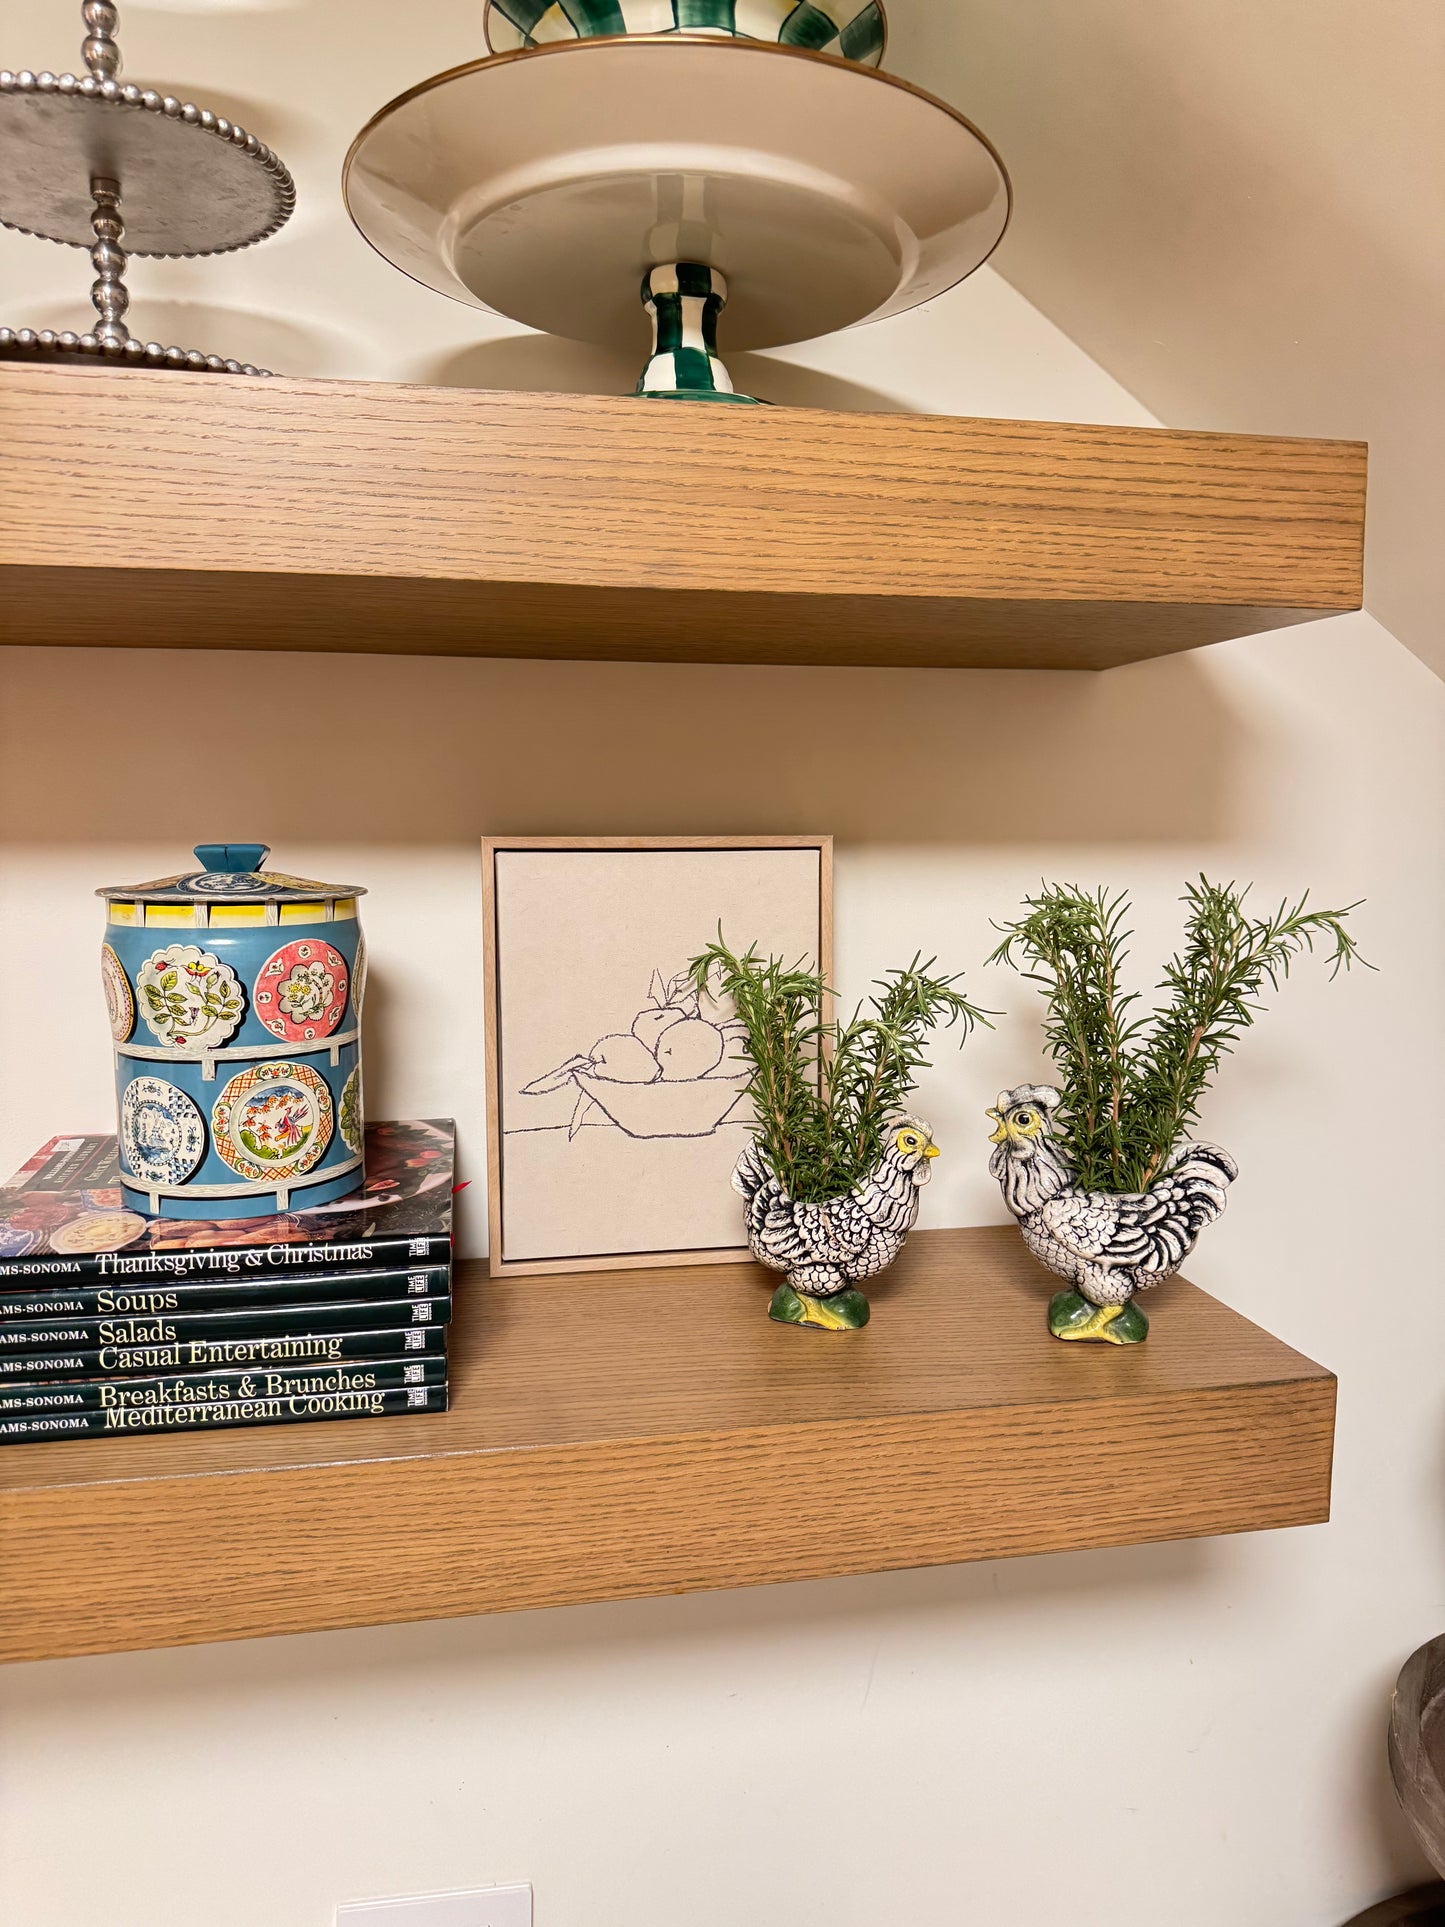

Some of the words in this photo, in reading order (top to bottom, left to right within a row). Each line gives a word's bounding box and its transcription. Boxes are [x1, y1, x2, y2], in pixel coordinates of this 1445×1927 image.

[95, 1247, 240, 1276] Thanksgiving
[245, 1249, 263, 1267] &
[267, 1242, 373, 1265] Christmas
[0, 1262, 81, 1276] MS-SONOMA
[407, 1275, 416, 1294] TIME
[415, 1274, 425, 1293] LIFE
[0, 1301, 84, 1315] MS-SONOMA
[97, 1289, 178, 1313] Soups
[411, 1304, 419, 1322] TIME
[419, 1303, 429, 1321] LIFE
[99, 1319, 177, 1345] Salads
[404, 1331, 412, 1350] TIME
[412, 1330, 421, 1349] LIFE
[99, 1341, 181, 1369] Casual
[188, 1332, 343, 1364] Entertaining
[403, 1365, 412, 1384] TIME
[411, 1364, 421, 1383] LIFE
[98, 1380, 230, 1408] Breakfasts
[237, 1375, 257, 1398] &
[264, 1368, 376, 1396] Brunches
[415, 1387, 425, 1406] LIFE
[0, 1394, 84, 1409] MS-SONOMA
[104, 1400, 282, 1429] Mediterranean
[289, 1390, 385, 1415] Cooking
